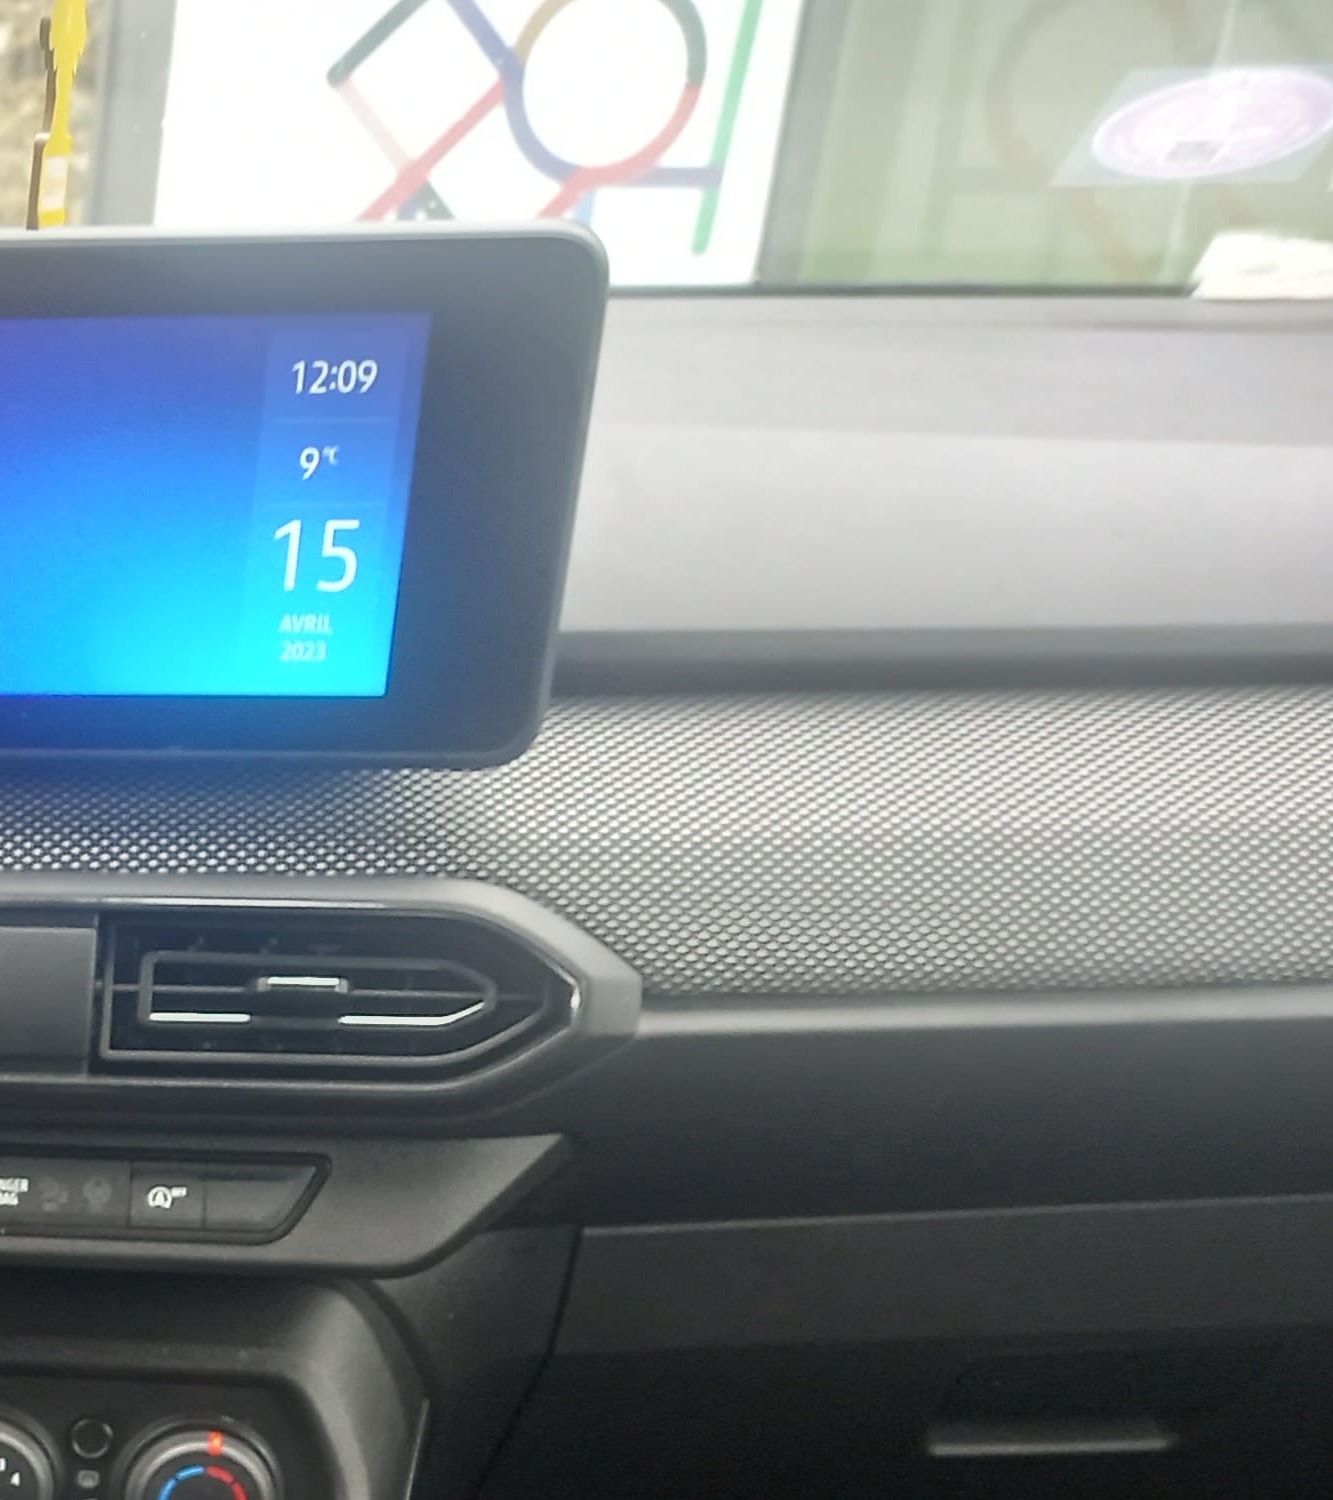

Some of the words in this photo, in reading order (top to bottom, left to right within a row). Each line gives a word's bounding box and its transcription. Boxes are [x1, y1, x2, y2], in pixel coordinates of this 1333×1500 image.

[291, 359, 378, 395] 12:09
[273, 518, 360, 592] 15
[279, 613, 332, 634] AVRIL
[279, 640, 327, 662] 2023
[9, 1471, 21, 1487] 4
